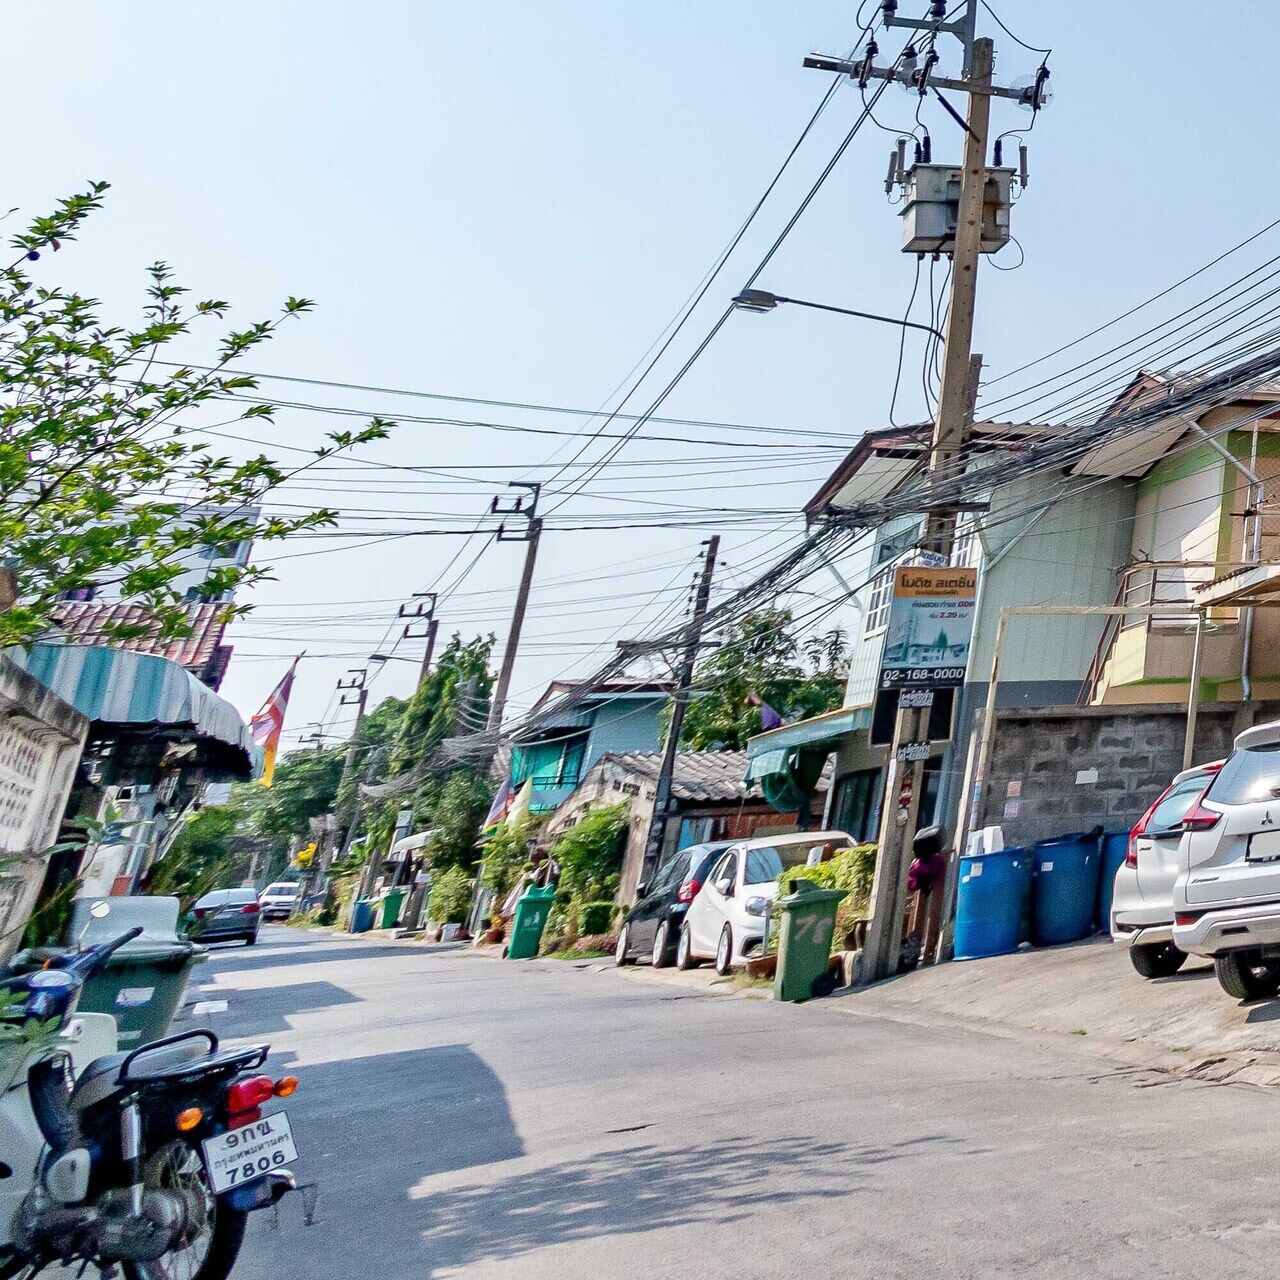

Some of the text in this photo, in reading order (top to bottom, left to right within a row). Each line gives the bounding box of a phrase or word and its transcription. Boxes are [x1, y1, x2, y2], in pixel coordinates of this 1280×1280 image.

[883, 669, 964, 681] 02-168-0000
[214, 1133, 289, 1169] กรุงเทพมหานคร
[226, 1150, 285, 1184] 7806
